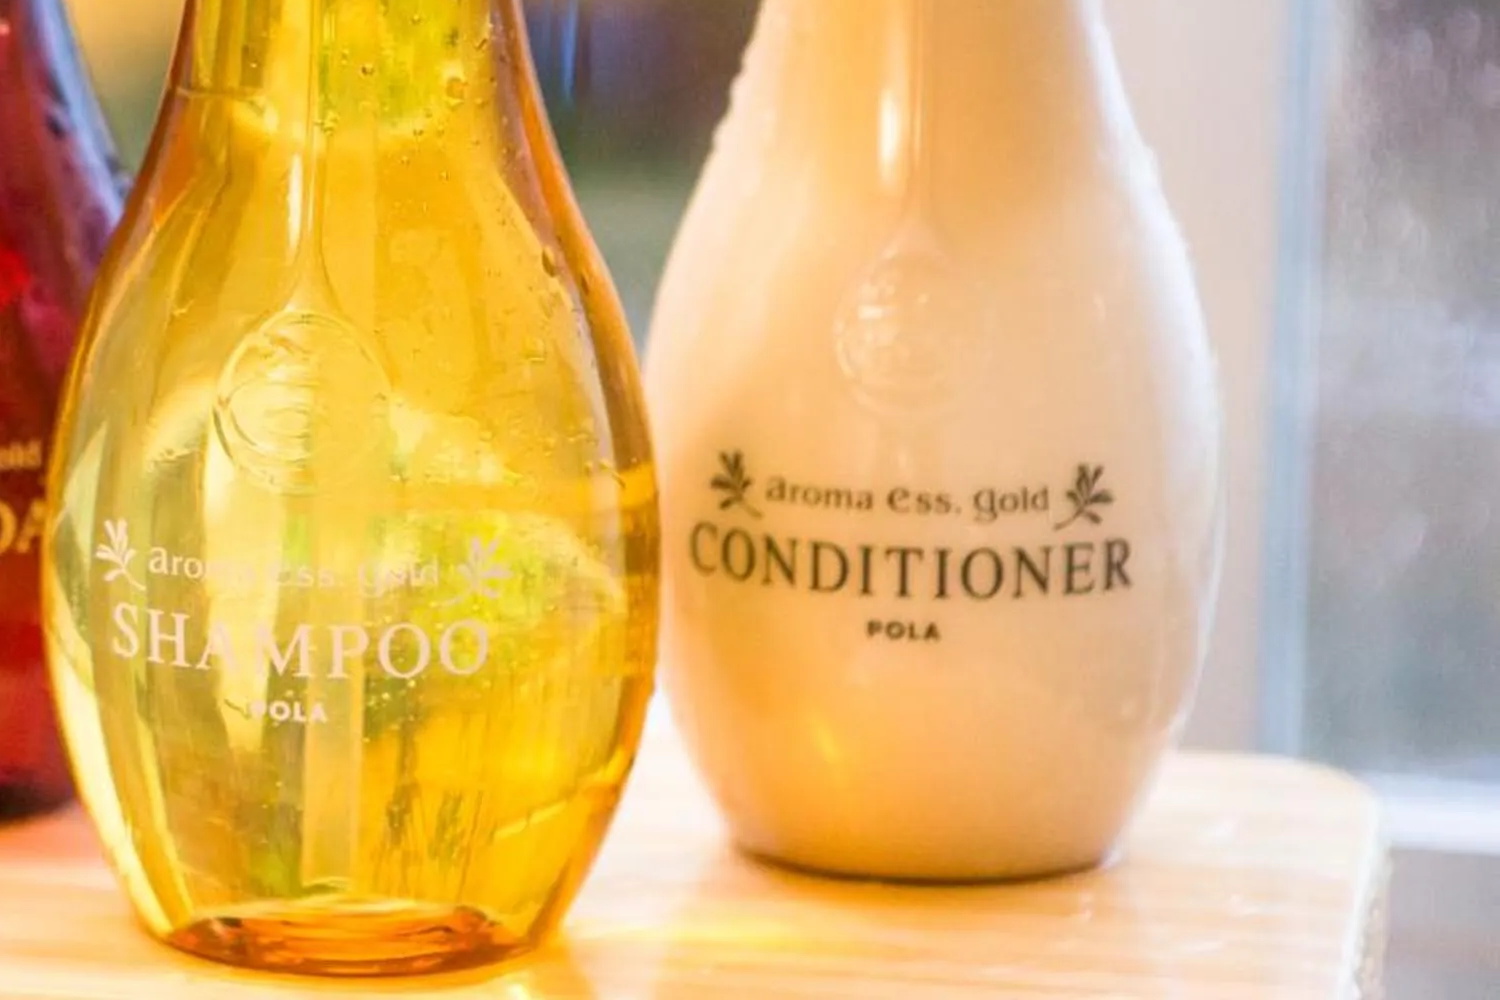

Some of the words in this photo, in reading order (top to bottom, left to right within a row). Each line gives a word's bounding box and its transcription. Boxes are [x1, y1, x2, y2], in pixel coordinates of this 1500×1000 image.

[765, 475, 874, 511] aroma
[886, 487, 962, 516] ess.
[973, 485, 1050, 523] gold
[689, 520, 1134, 600] CONDITIONER
[112, 602, 490, 679] SHAMPOO
[866, 620, 942, 641] POLA
[248, 699, 328, 723] POLA
